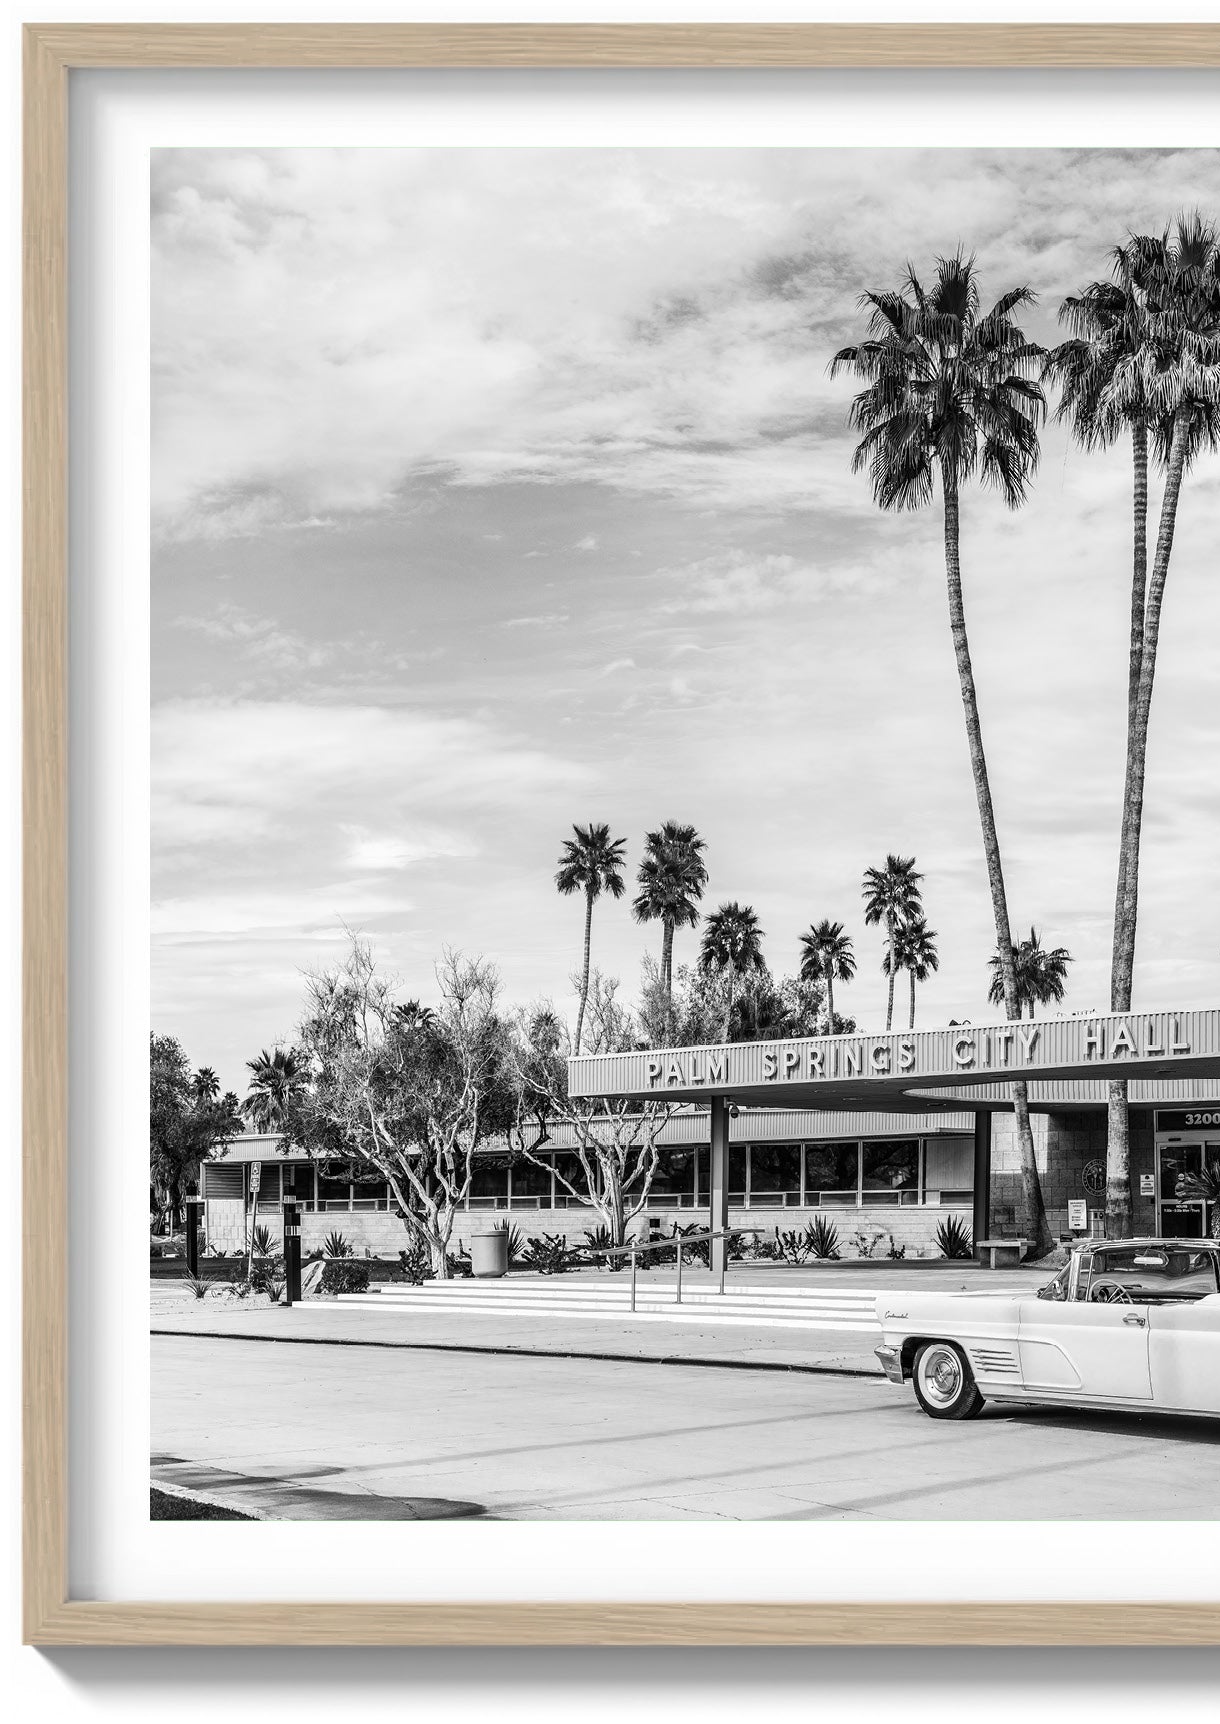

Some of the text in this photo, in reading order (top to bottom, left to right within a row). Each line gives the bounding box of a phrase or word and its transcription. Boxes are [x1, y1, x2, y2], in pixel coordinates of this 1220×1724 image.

[646, 1018, 1190, 1086] PALM SPRINGS CITY HALL
